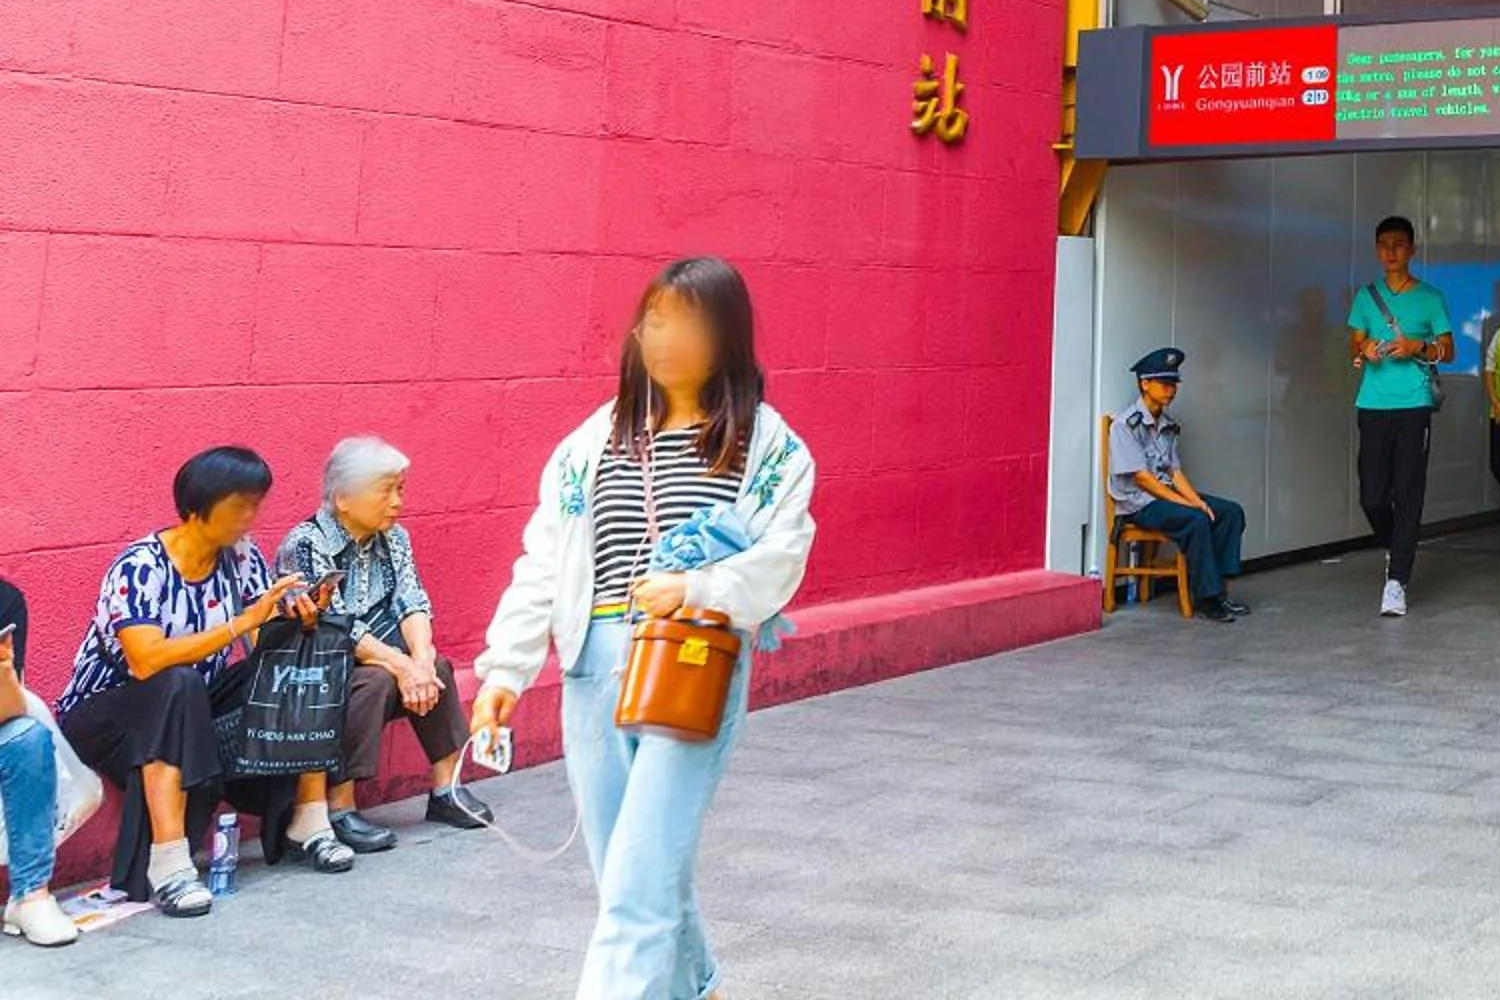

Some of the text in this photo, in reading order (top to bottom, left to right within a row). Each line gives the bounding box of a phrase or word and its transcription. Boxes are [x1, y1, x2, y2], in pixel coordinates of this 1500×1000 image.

[1347, 53, 1372, 65] Dear
[1455, 47, 1473, 59] for
[1198, 60, 1292, 90] 公园前站
[1403, 68, 1442, 83] please
[1447, 65, 1461, 78] do
[1467, 64, 1487, 77] not
[1365, 91, 1380, 101] or
[1421, 86, 1436, 98] of
[1195, 97, 1295, 112] Gongyuanqian
[1336, 107, 1385, 121] electric
[1390, 103, 1428, 118] travel
